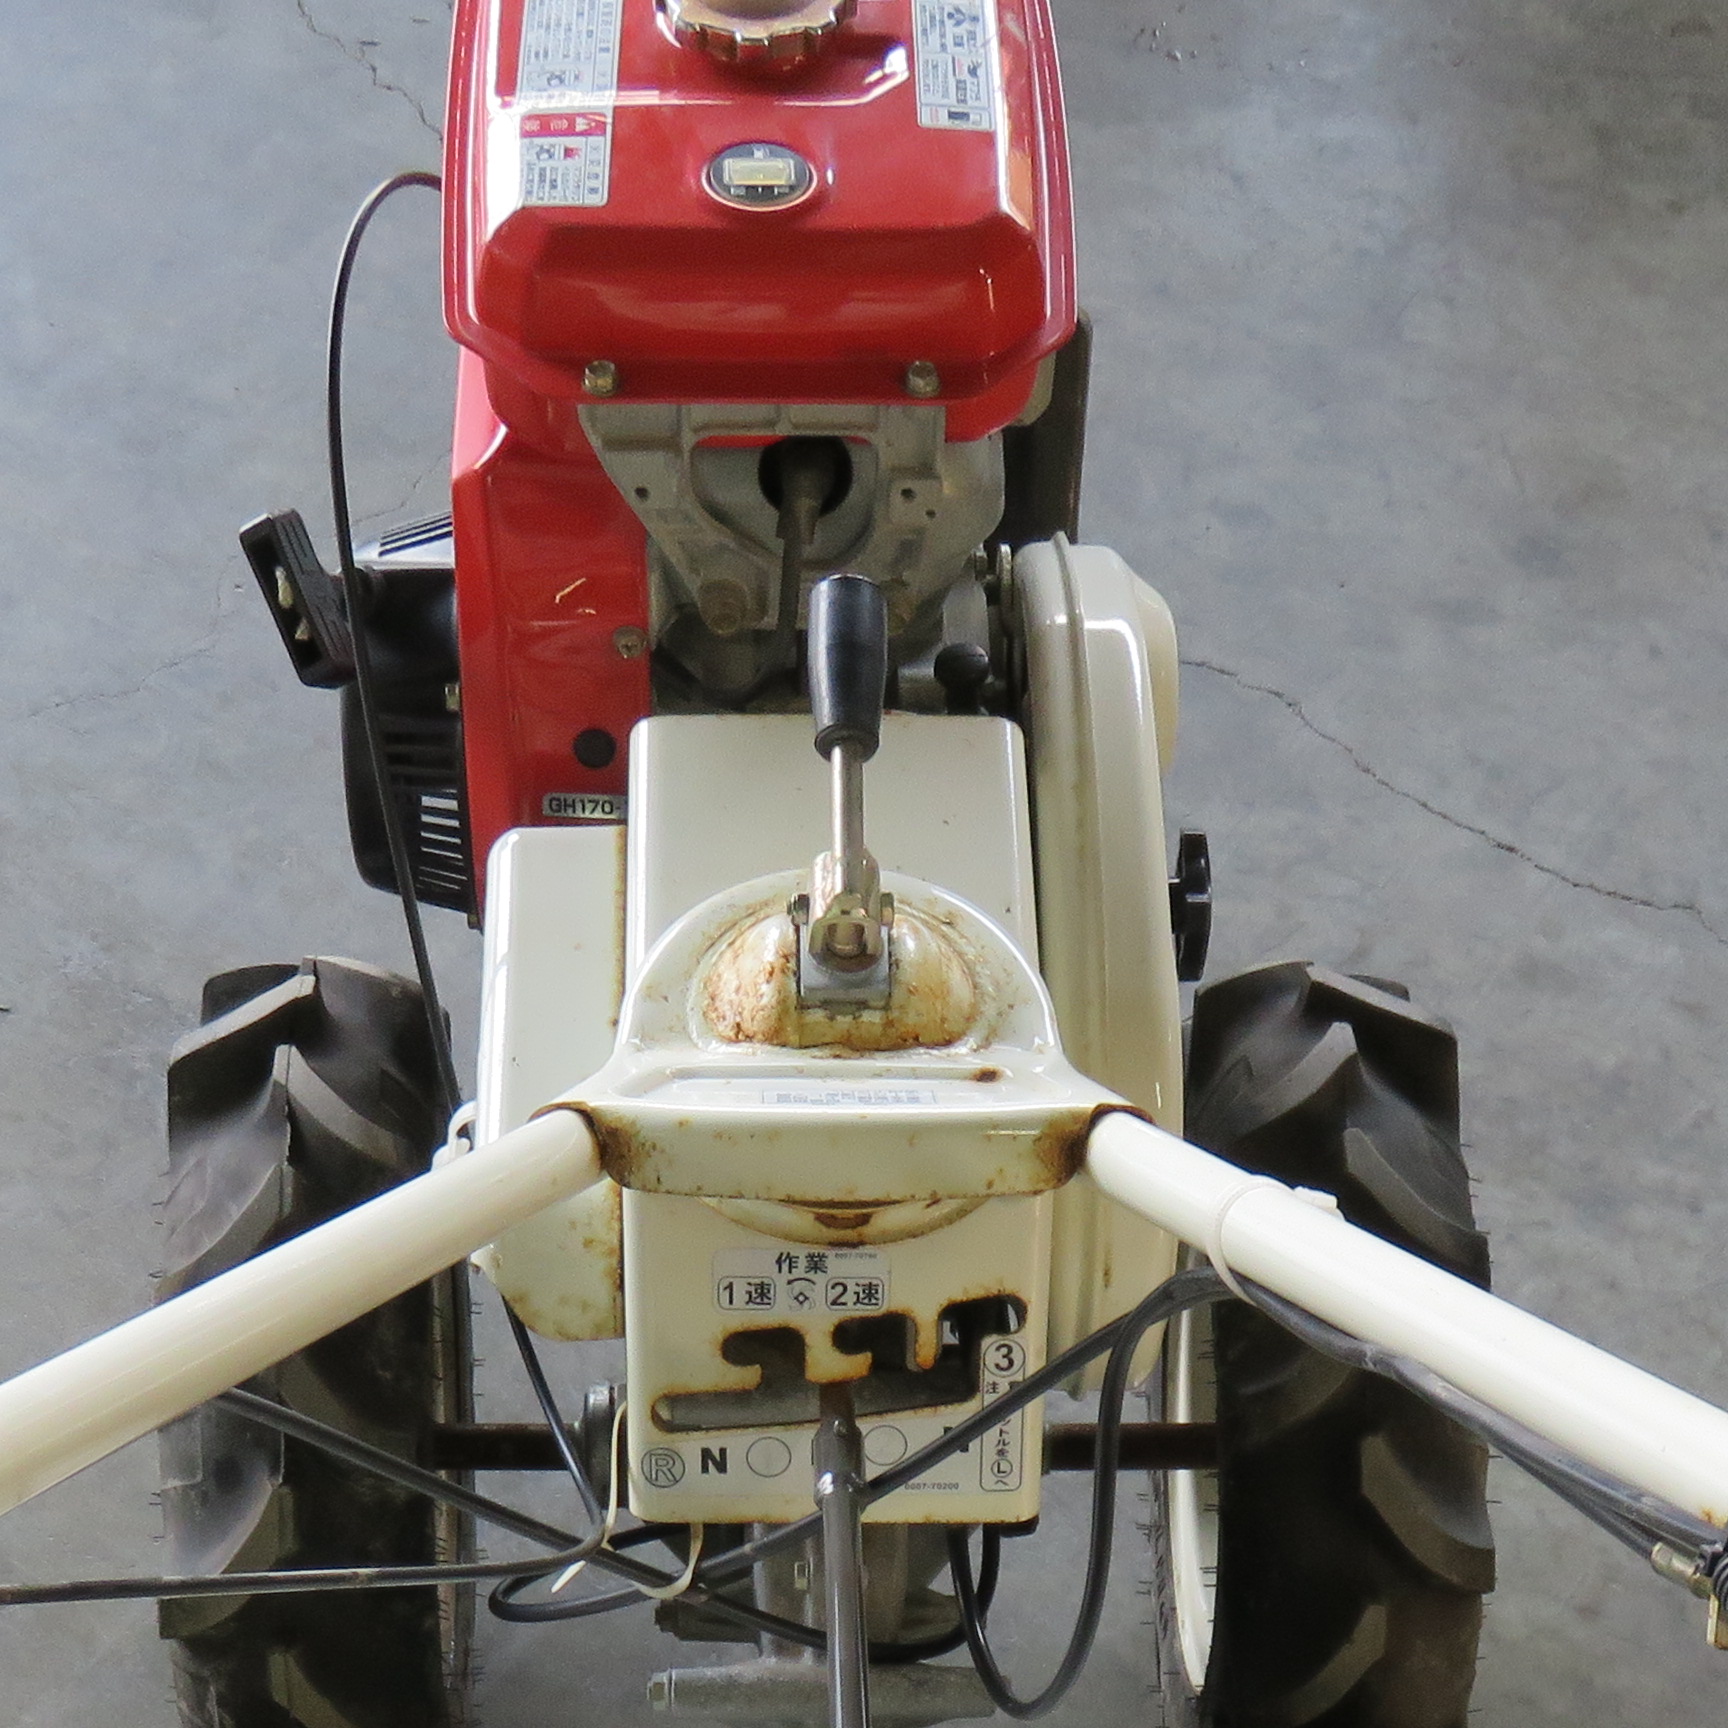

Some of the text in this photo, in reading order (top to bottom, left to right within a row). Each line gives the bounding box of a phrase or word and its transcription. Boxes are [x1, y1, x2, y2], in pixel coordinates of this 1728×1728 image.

[548, 797, 627, 815] GH170-
[775, 1252, 829, 1274] 作業
[993, 1343, 1015, 1372] 3
[700, 1446, 728, 1475] N
